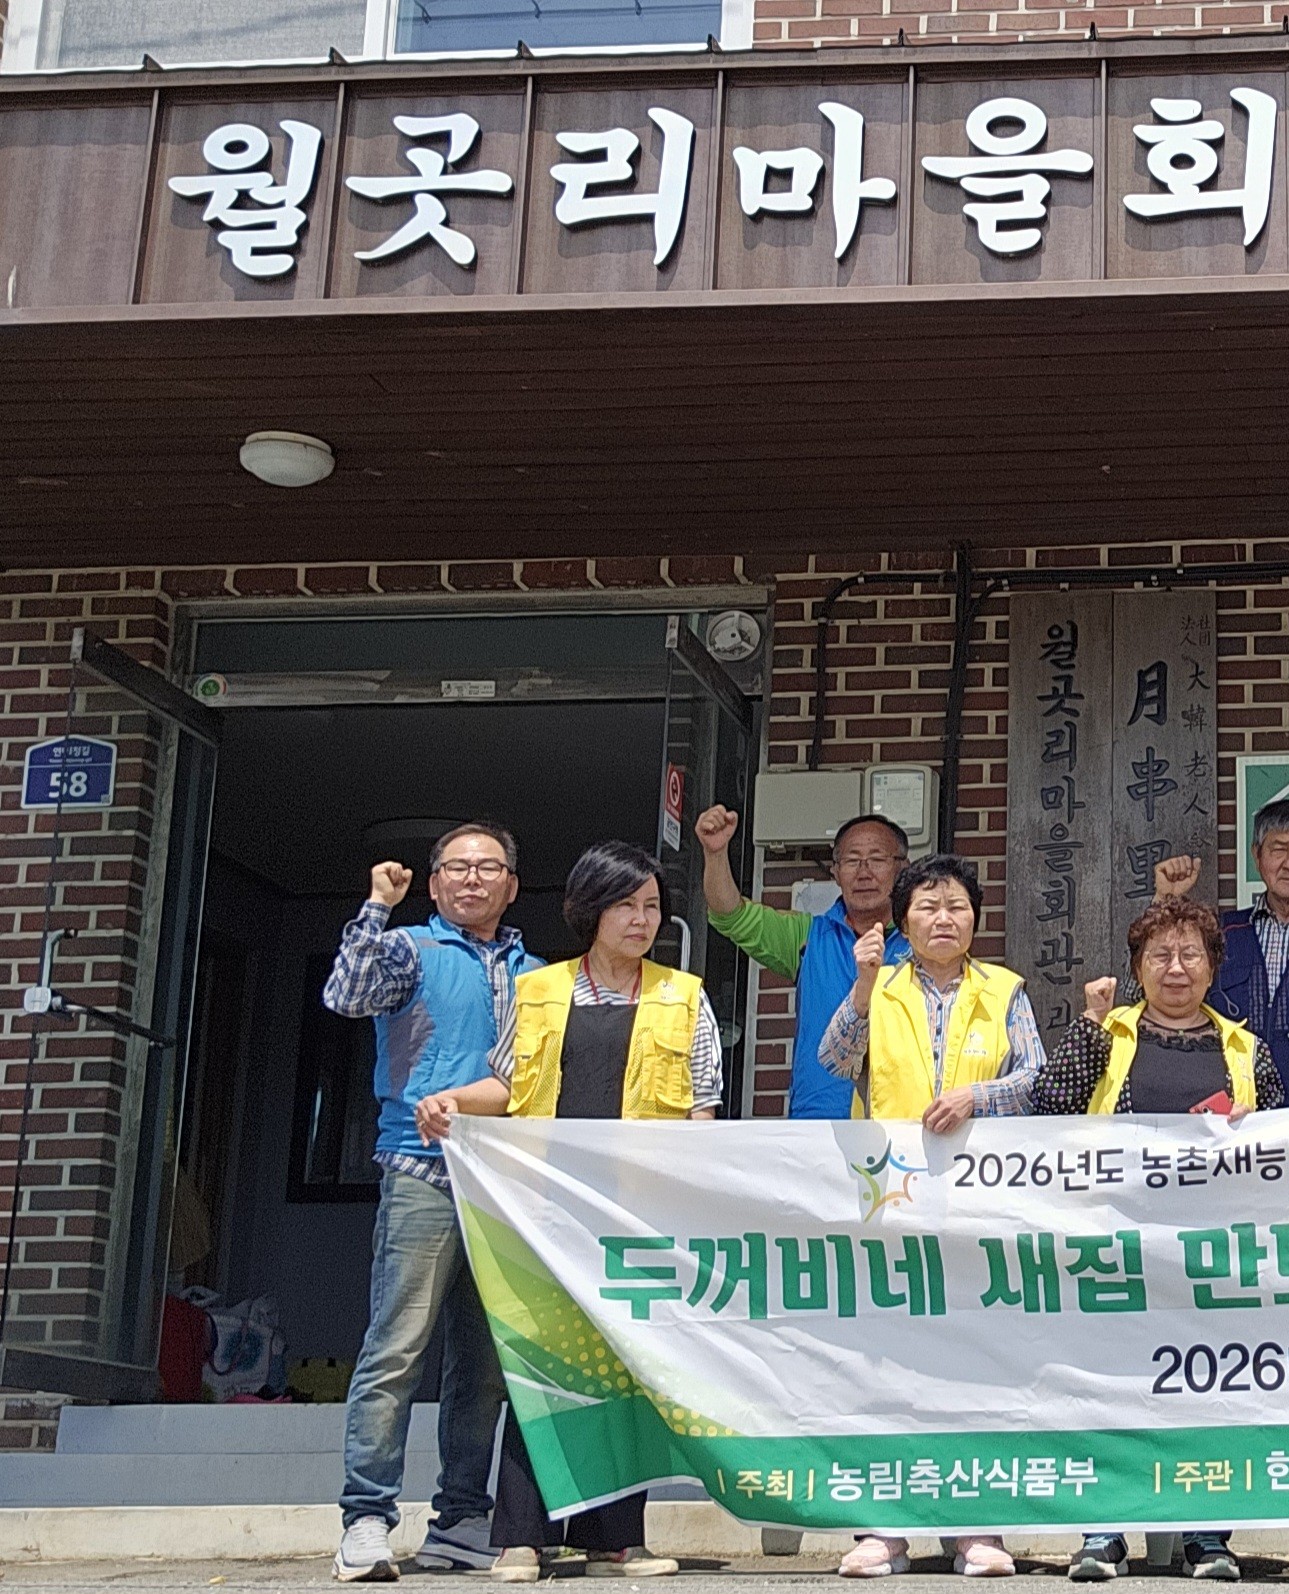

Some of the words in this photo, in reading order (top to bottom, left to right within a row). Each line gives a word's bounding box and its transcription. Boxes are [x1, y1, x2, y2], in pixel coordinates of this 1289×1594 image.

[48, 771, 88, 798] 58
[1034, 620, 1086, 984] 월곳리마을회관
[953, 1147, 1125, 1192] 2026년도
[599, 1232, 948, 1320] 두꺼비네
[978, 1229, 1147, 1313] 새집
[735, 1469, 794, 1501] 주최
[827, 1456, 1099, 1501] 농림축산식품부
[1173, 1460, 1234, 1493] 주관
